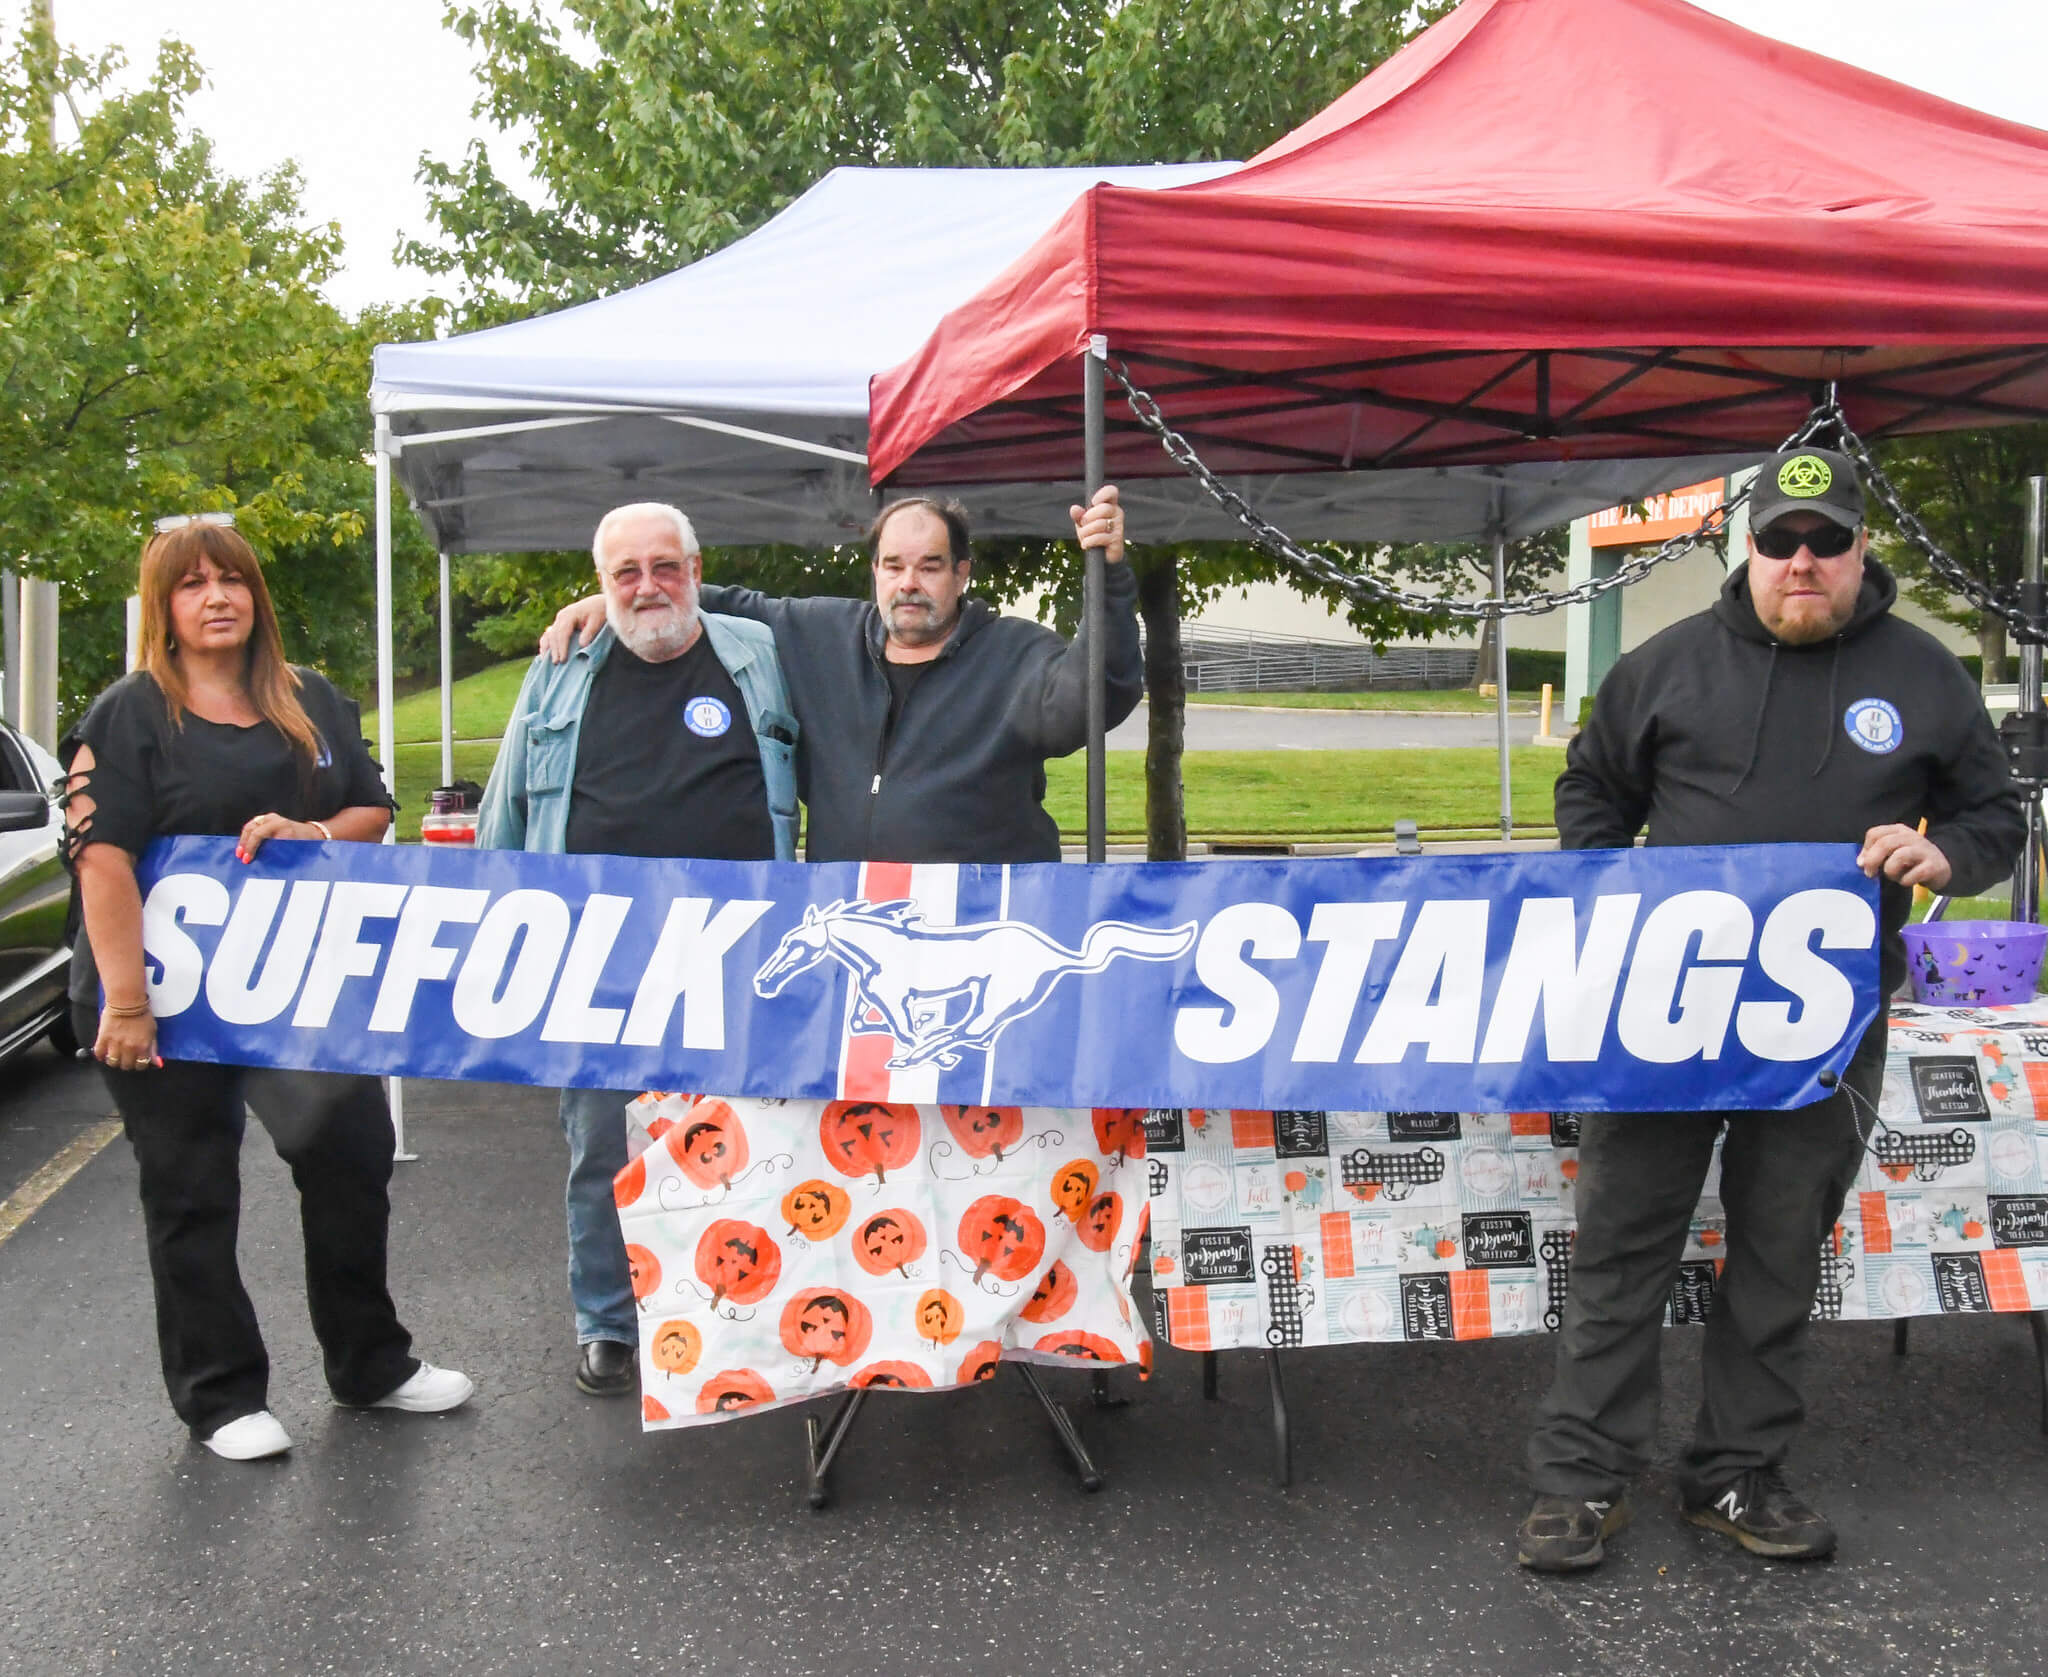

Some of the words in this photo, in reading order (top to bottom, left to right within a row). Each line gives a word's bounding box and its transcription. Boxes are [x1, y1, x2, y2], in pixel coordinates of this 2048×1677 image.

[1667, 491, 1723, 520] DEPOT
[143, 872, 777, 1051] SUFFOLK
[1173, 889, 1877, 1065] STANGS
[1927, 1082, 1977, 1101] Thankful
[1410, 1118, 1440, 1128] BLESSED
[1480, 1220, 1513, 1230] BLESSED
[1200, 1236, 1231, 1246] BLESSED
[1467, 1230, 1528, 1251] Thankful
[1186, 1245, 1248, 1268] Thankful
[1480, 1250, 1519, 1259] GRATEFUL
[1200, 1264, 1238, 1275] GRATEFUL
[1940, 1271, 1955, 1308] GRATEFUL
[1946, 1259, 1977, 1312] Thankful
[1969, 1271, 1983, 1303] BLESSED
[1408, 1293, 1419, 1333] GRATEFUL
[1416, 1280, 1441, 1340] Thankful
[1437, 1294, 1448, 1328] BLESSED
